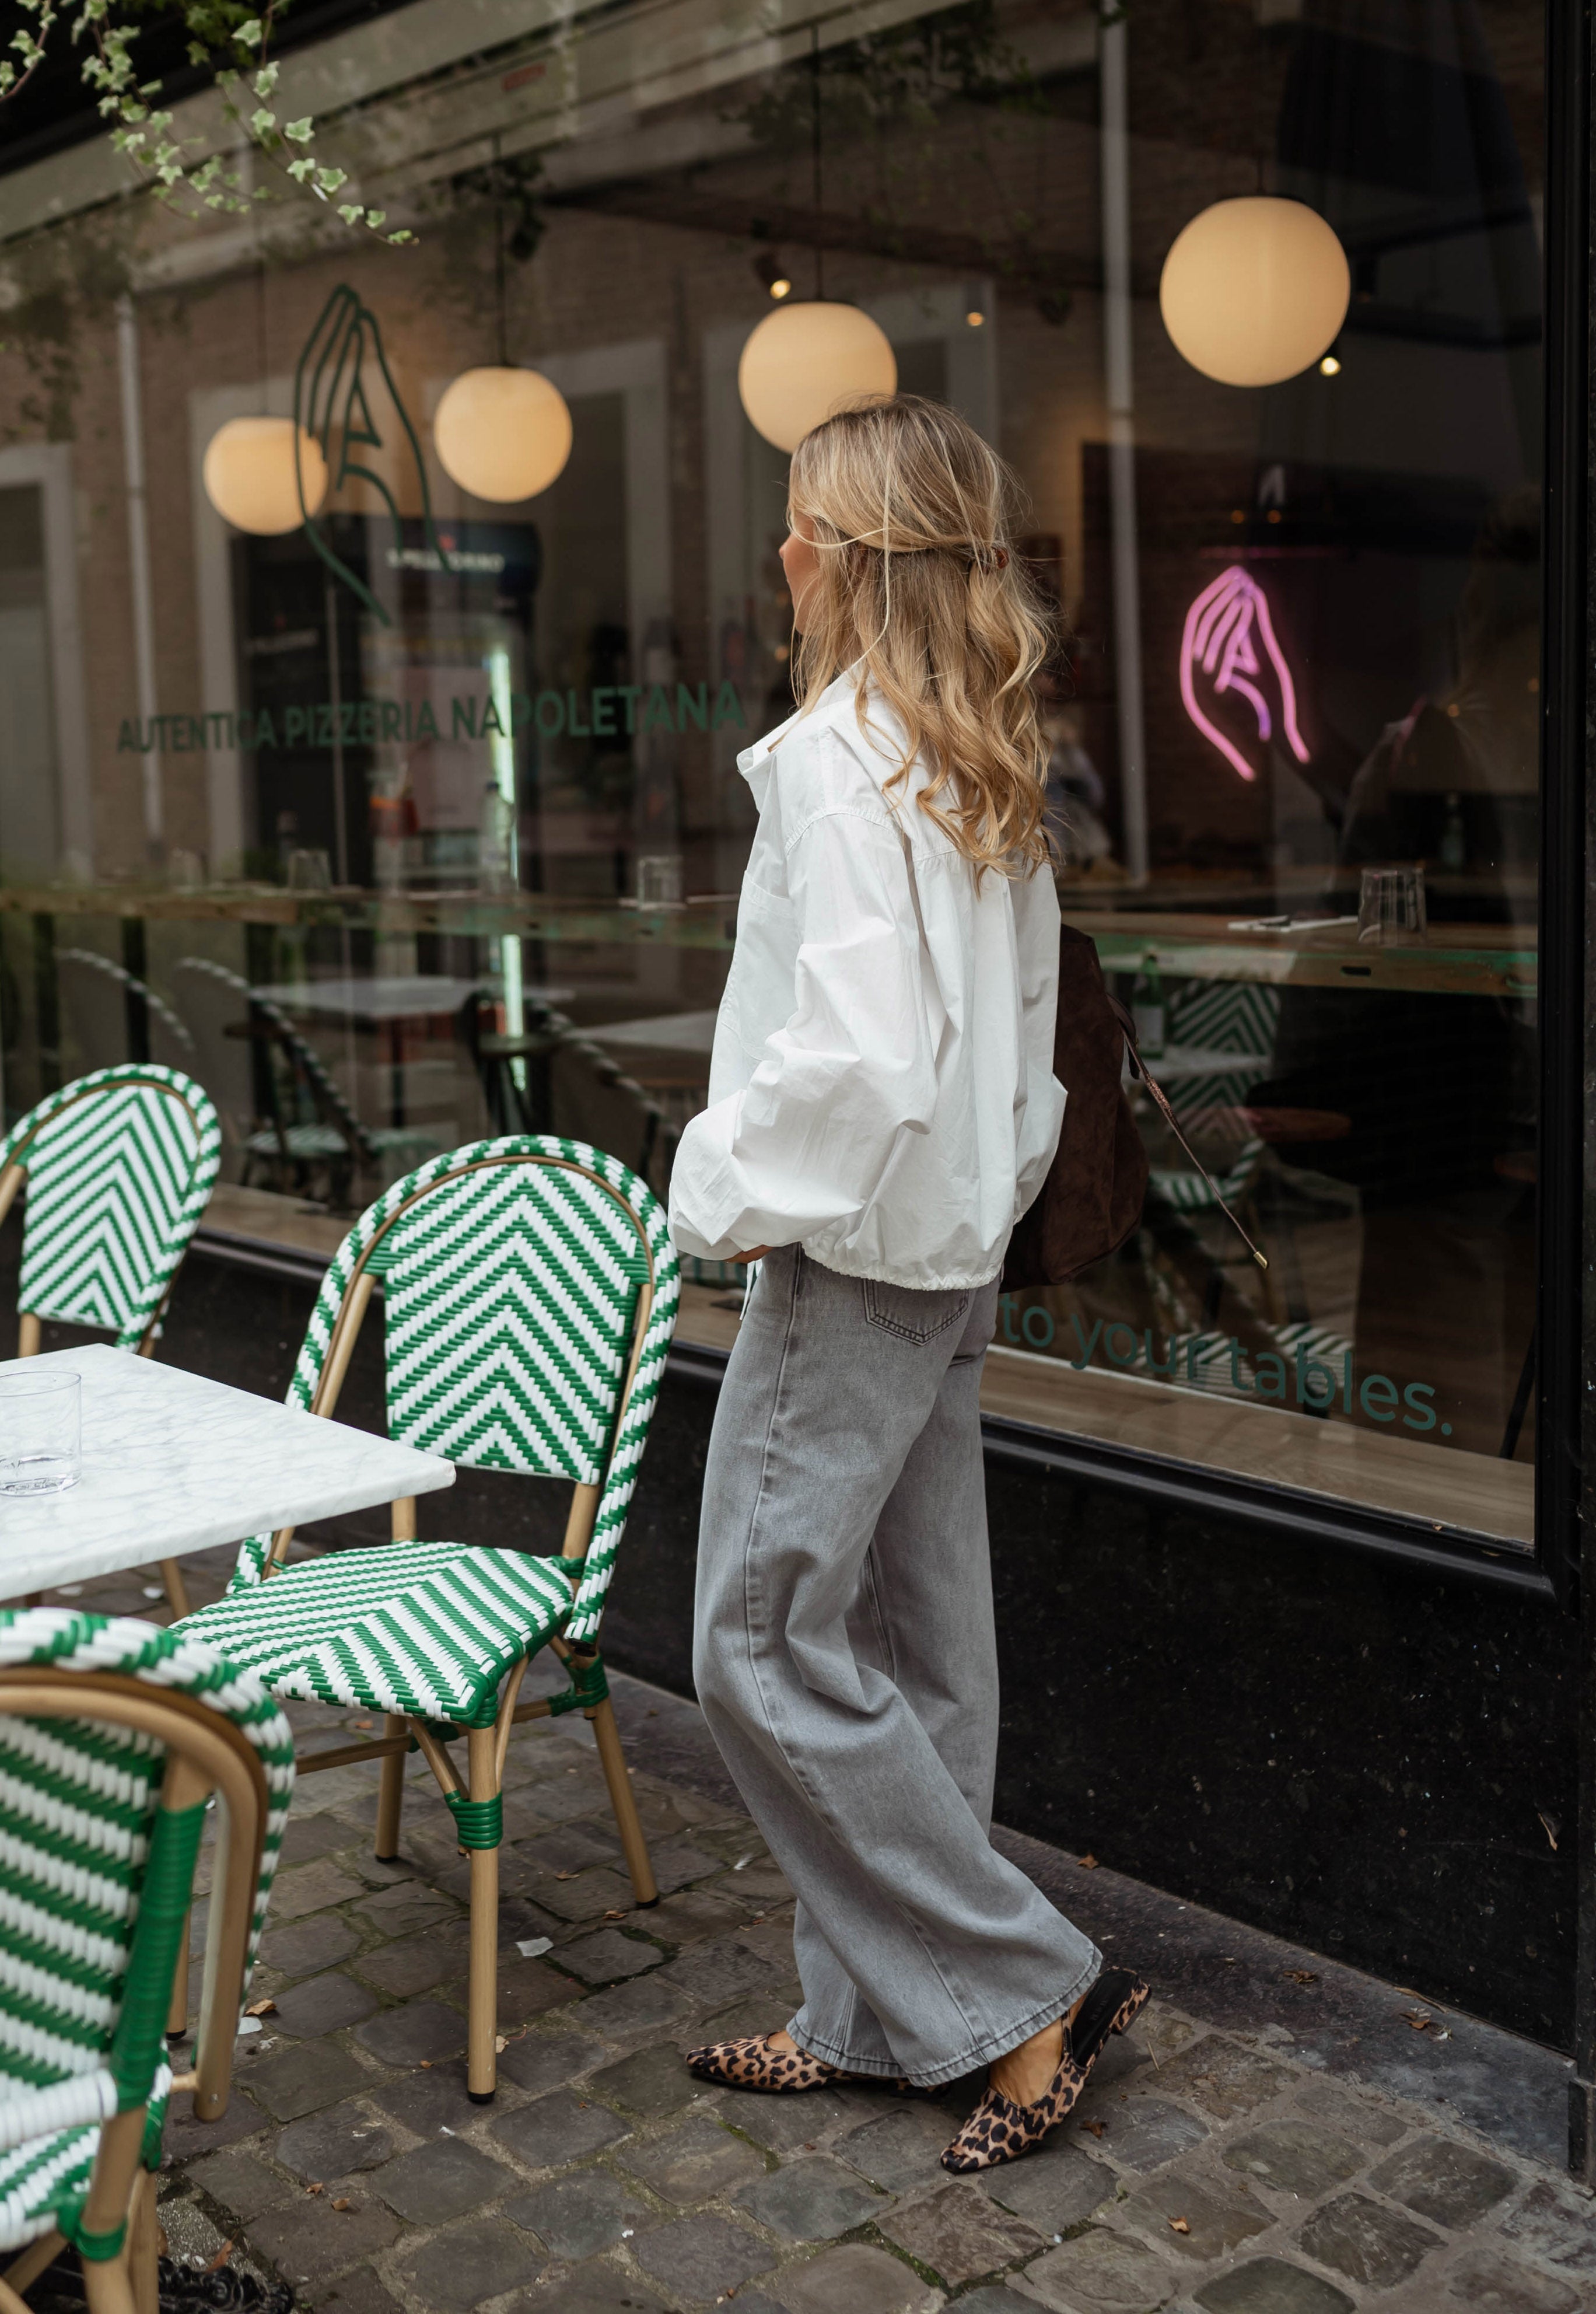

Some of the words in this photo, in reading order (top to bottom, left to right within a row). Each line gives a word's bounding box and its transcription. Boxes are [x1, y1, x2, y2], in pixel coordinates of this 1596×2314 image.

[117, 710, 278, 753] AUTENTICA
[285, 699, 441, 747] PIZZERIA
[452, 680, 747, 739] NAPOLETANA
[999, 1293, 1055, 1348] to
[1070, 1313, 1209, 1380] your
[1226, 1336, 1453, 1436] tables.
